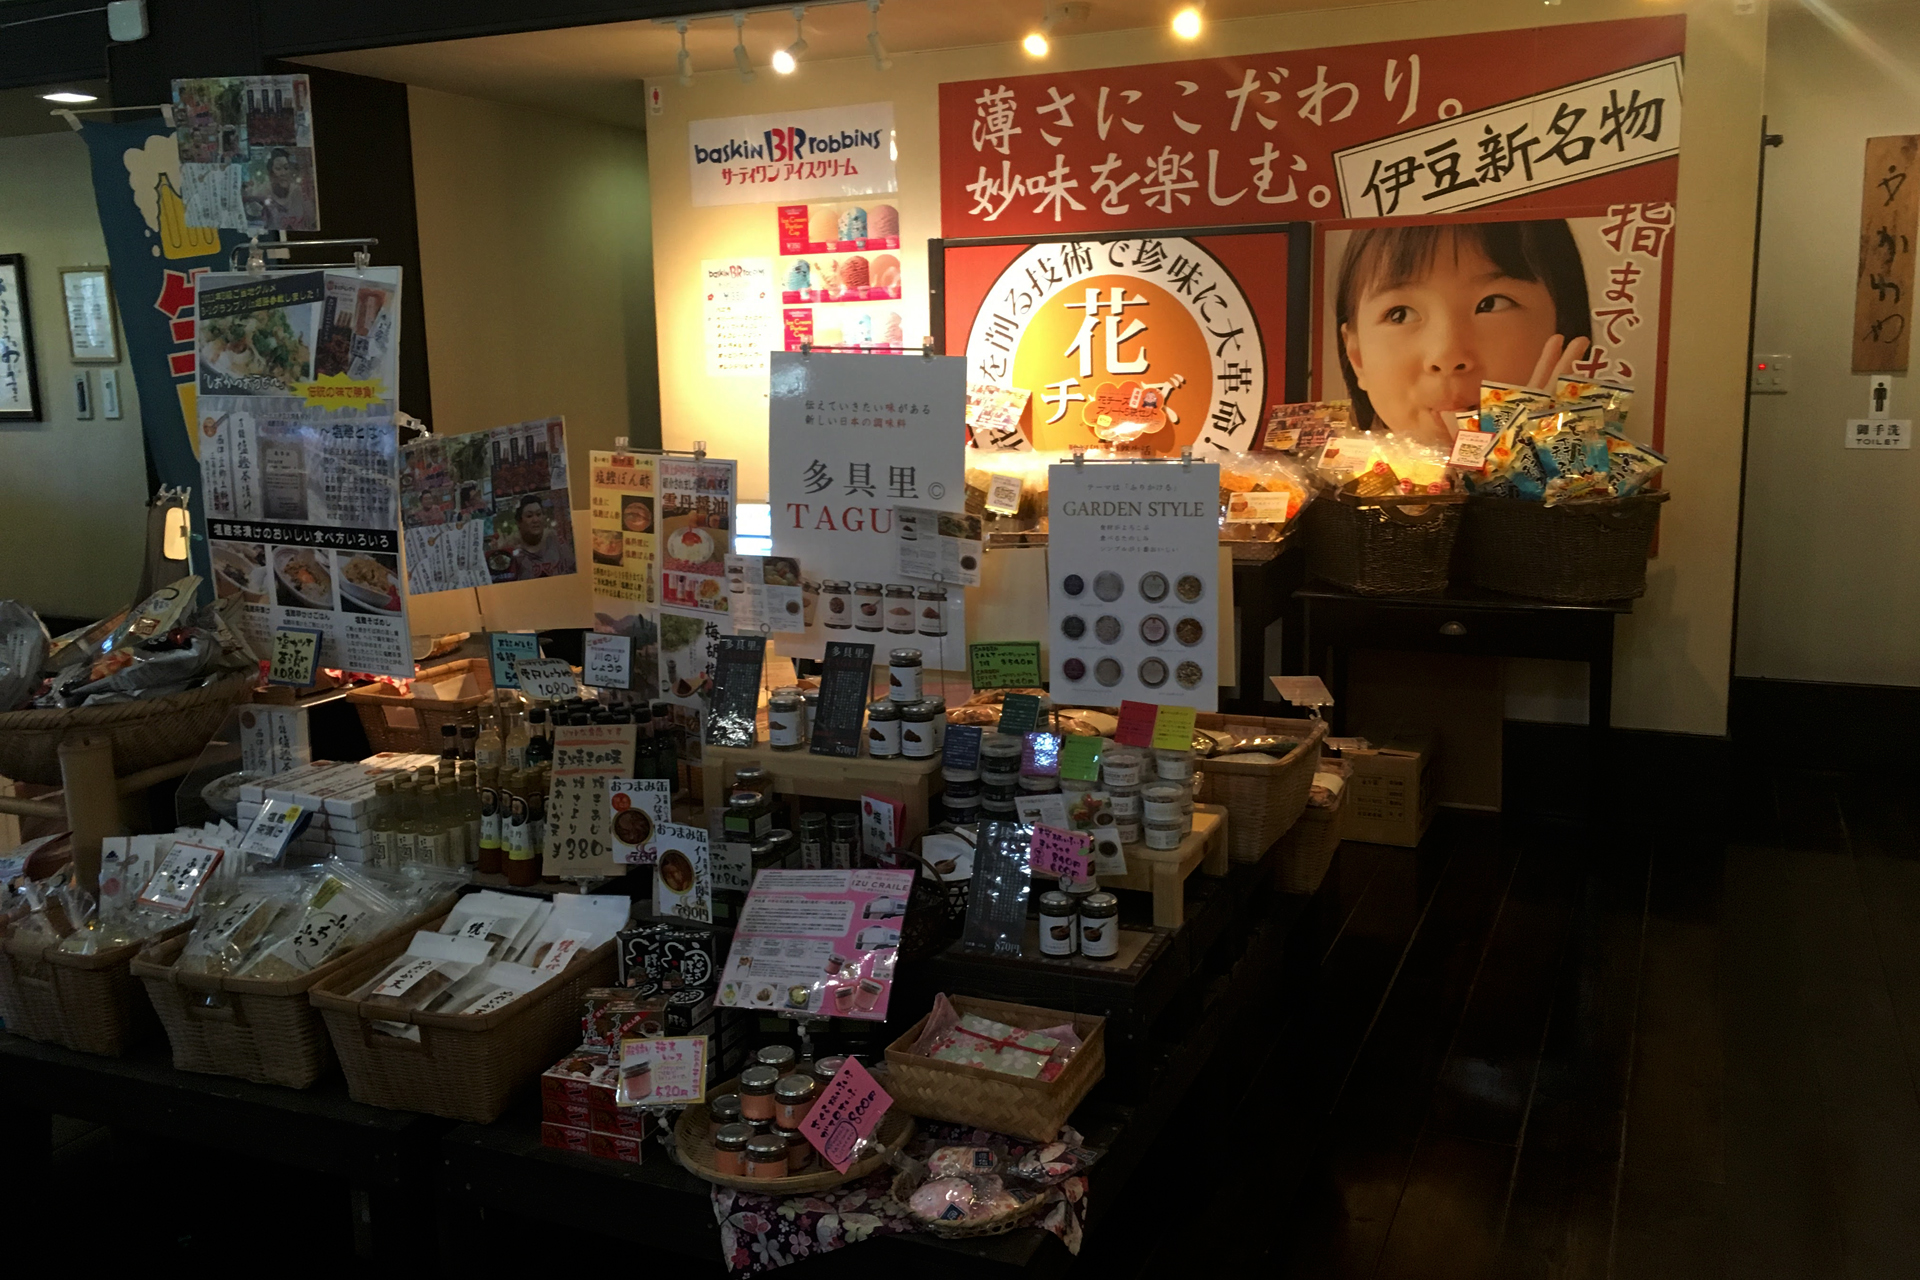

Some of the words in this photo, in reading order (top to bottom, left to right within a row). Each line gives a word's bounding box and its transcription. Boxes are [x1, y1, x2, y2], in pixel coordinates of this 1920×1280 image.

[971, 54, 1462, 155] 薄さにこだわり。
[694, 138, 763, 164] baskin
[764, 127, 806, 162] BR
[809, 129, 882, 151] robbins
[1362, 88, 1665, 217] 伊豆新名物
[722, 164, 780, 186] サーティワン
[784, 158, 858, 181] アイスクリーム
[965, 142, 1332, 221] 妙味を楽しむ。
[1064, 287, 1150, 377] 花
[805, 400, 931, 416] 伝えていきたい味がある
[805, 415, 907, 429] 新しい日本の調味料
[1857, 424, 1900, 436] 御手洗
[1856, 437, 1900, 446] TOILET
[1063, 501, 1142, 517] GARDEN
[1148, 501, 1205, 517] STYLE
[610, 780, 668, 793] おつまみ缶
[657, 823, 707, 843] おつまみ缶
[851, 880, 869, 888] IZU
